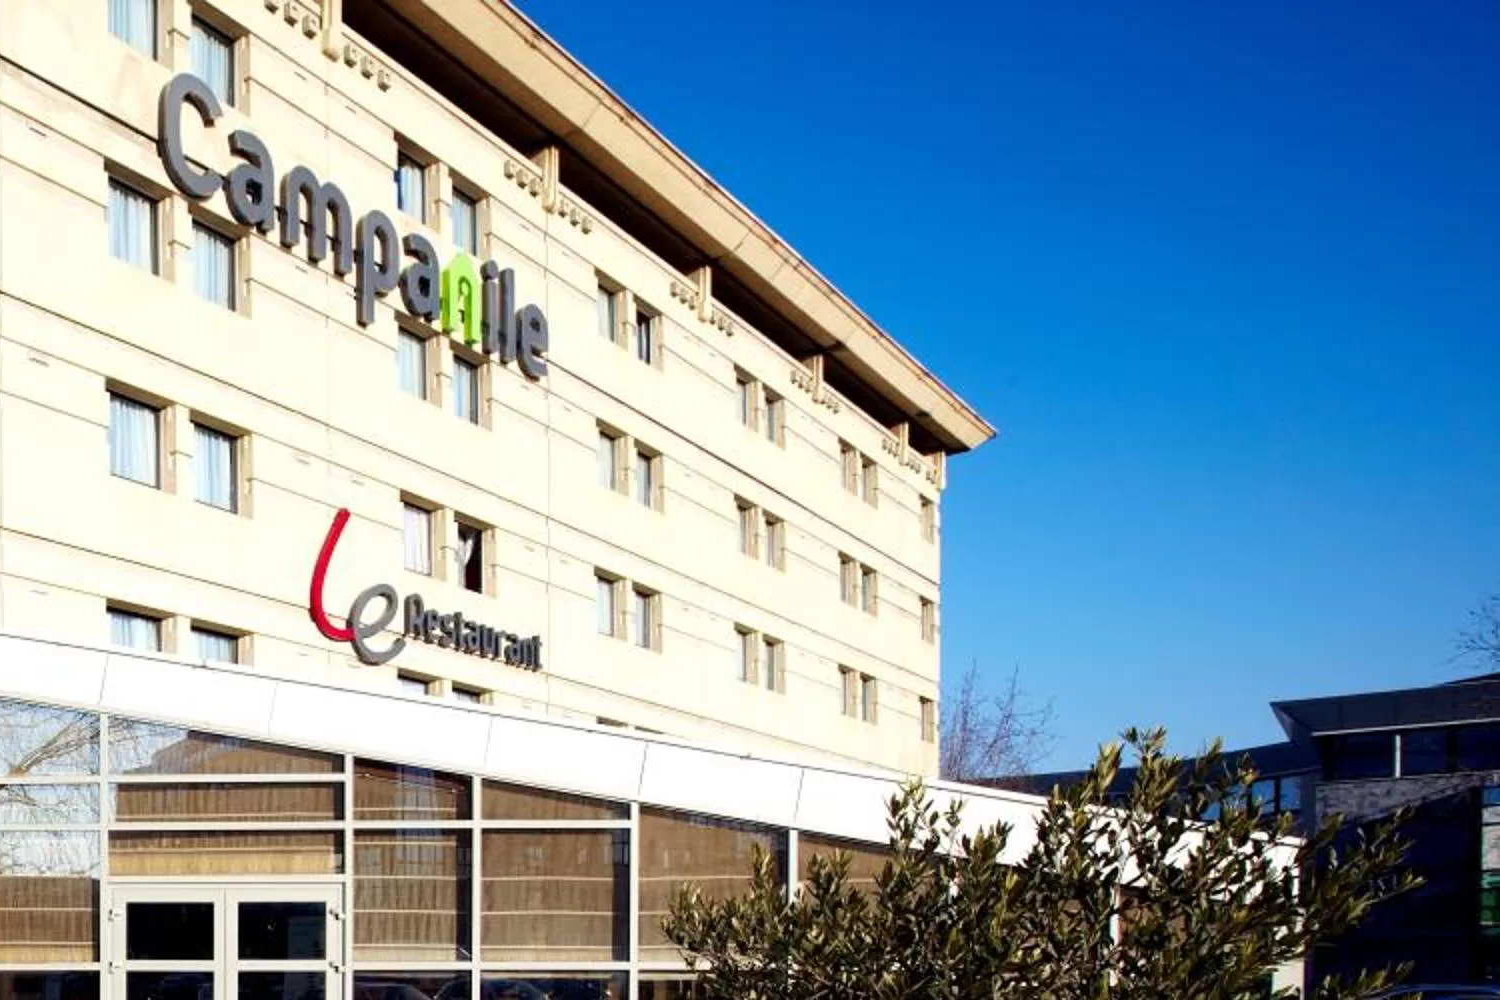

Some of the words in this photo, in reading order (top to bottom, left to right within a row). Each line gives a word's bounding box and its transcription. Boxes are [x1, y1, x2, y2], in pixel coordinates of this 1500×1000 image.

[158, 72, 549, 381] Campanile
[308, 508, 406, 665] Le
[404, 593, 543, 672] Restaurant
